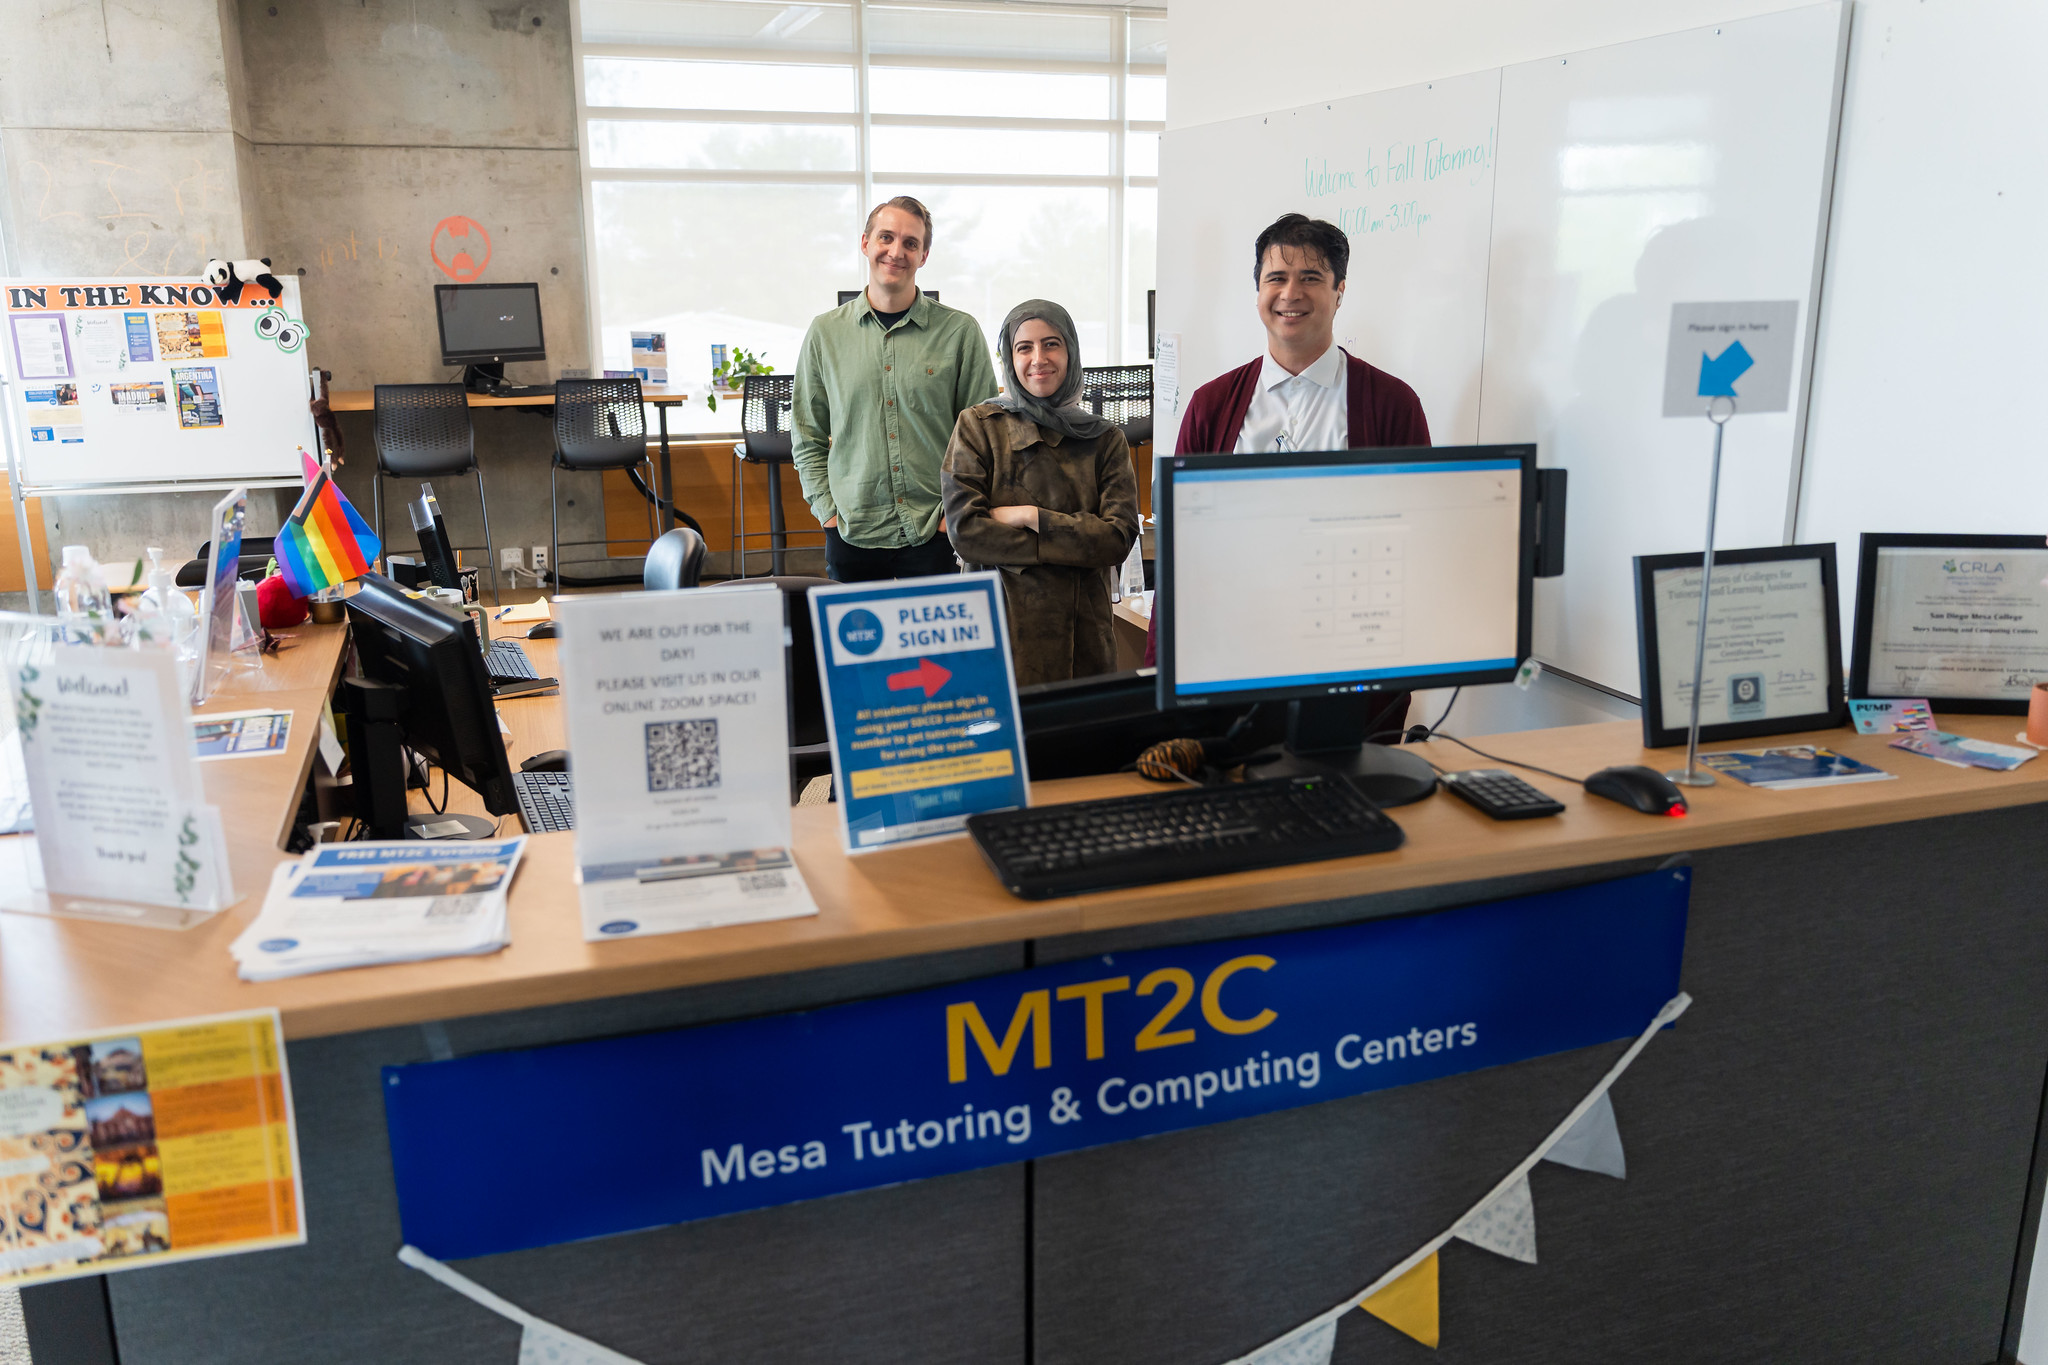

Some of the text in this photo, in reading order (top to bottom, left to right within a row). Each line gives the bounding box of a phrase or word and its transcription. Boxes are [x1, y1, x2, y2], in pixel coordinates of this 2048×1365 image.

[1365, 147, 1380, 190] to
[1387, 141, 1416, 184] Fall
[9, 288, 47, 309] IN
[61, 286, 131, 307] THE
[1749, 323, 1769, 331] here
[175, 371, 214, 381] ARGENTINA
[117, 391, 150, 401] MADRID
[1960, 561, 2006, 573] CRLA
[899, 602, 974, 625] PLEASE,
[600, 621, 752, 642] WE ARE OUT FOR THE
[898, 624, 980, 648] SIGN IN!
[660, 648, 695, 662] DAY!
[597, 669, 761, 691] PLEASE VISIT US IN OUR
[603, 693, 757, 715] ONLINE ZOOM SPACE!
[856, 709, 871, 721] All
[922, 700, 954, 713] please
[956, 697, 976, 709] sign
[977, 695, 988, 705] in
[1856, 703, 1893, 712] PUMP
[855, 724, 884, 736] using
[886, 721, 909, 734] your
[945, 711, 982, 723] student
[984, 708, 995, 718] ID
[851, 738, 891, 750] number
[893, 734, 905, 743] to
[907, 732, 924, 744] get
[337, 849, 376, 860] FREE
[944, 953, 1279, 1085] MT2C
[701, 1022, 1478, 1187] Mesa Tutoring & Computing Centers
